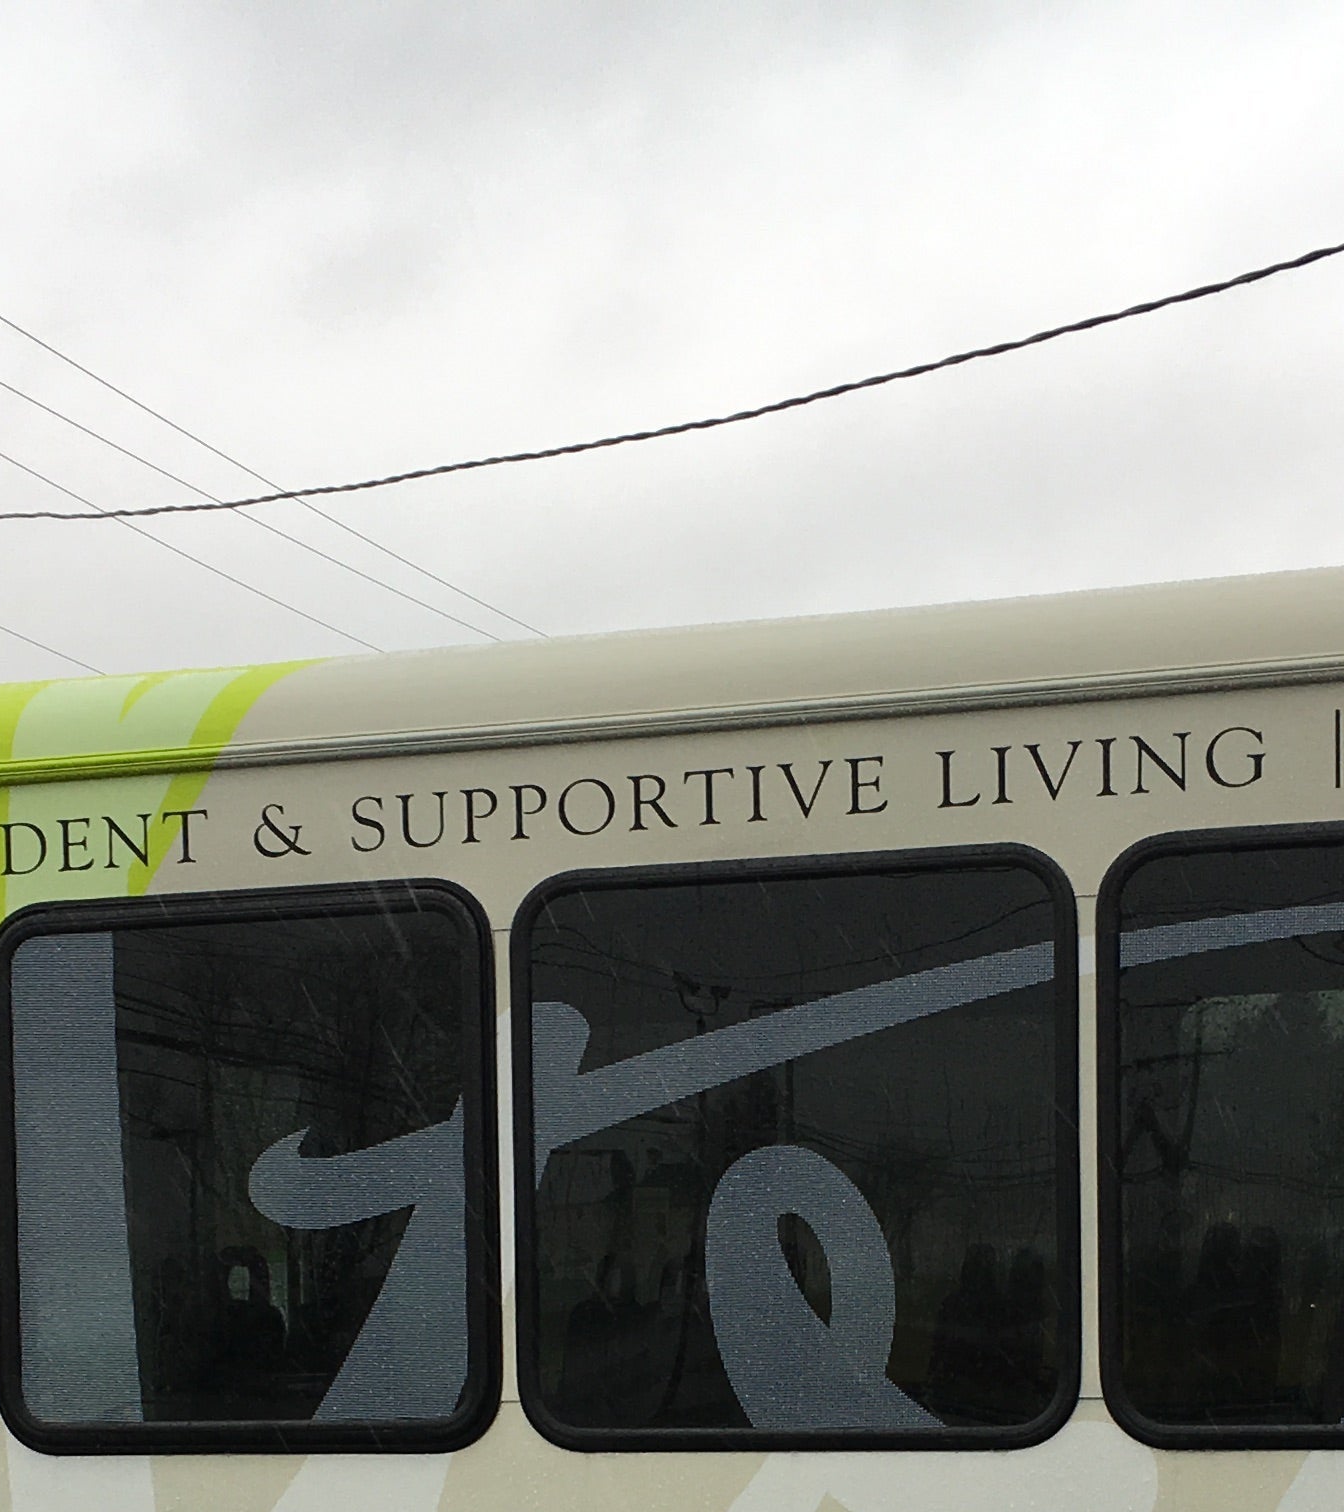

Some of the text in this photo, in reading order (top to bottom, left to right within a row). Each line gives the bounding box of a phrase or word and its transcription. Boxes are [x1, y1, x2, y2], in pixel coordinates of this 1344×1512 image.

[253, 803, 312, 858] &
[350, 755, 889, 853] SUPPORTIVE
[936, 726, 1268, 810] LIVING
